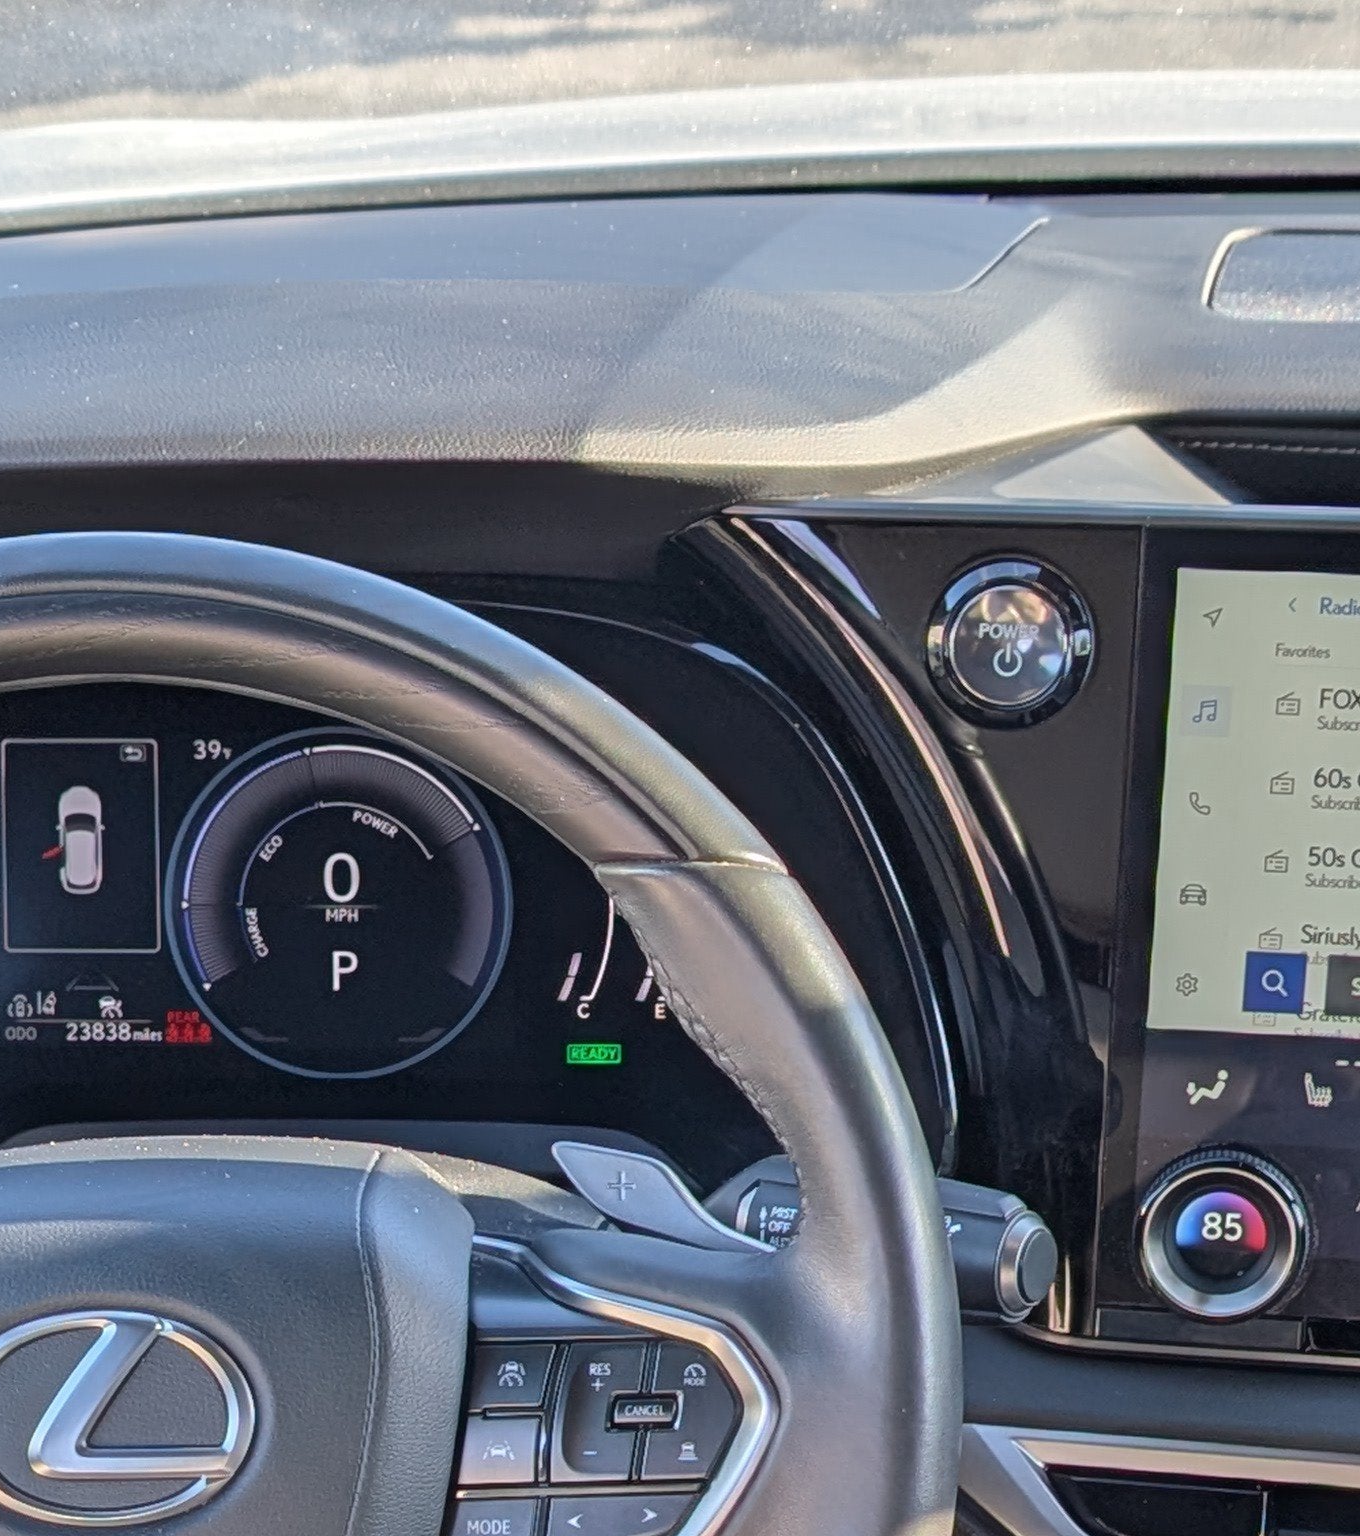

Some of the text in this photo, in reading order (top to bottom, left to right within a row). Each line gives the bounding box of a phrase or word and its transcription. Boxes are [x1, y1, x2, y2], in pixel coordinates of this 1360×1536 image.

[978, 621, 1040, 641] POWER
[1274, 642, 1331, 659] Favorites
[1313, 767, 1352, 790] 60s
[352, 810, 399, 839] POWER
[258, 834, 284, 863] ECO
[1307, 846, 1346, 868] 50s
[323, 852, 360, 904] 0
[325, 908, 360, 923] MPH
[244, 907, 270, 958] CHARGE
[331, 950, 359, 992] P
[576, 1002, 591, 1019] C
[654, 1002, 667, 1020] E
[4, 1021, 163, 1042] ODO 23838 miles
[571, 1048, 617, 1061] READY
[1200, 1211, 1243, 1242] 85
[589, 1362, 611, 1376] RES
[623, 1403, 666, 1418] CANCEL
[467, 1519, 512, 1535] MODE
